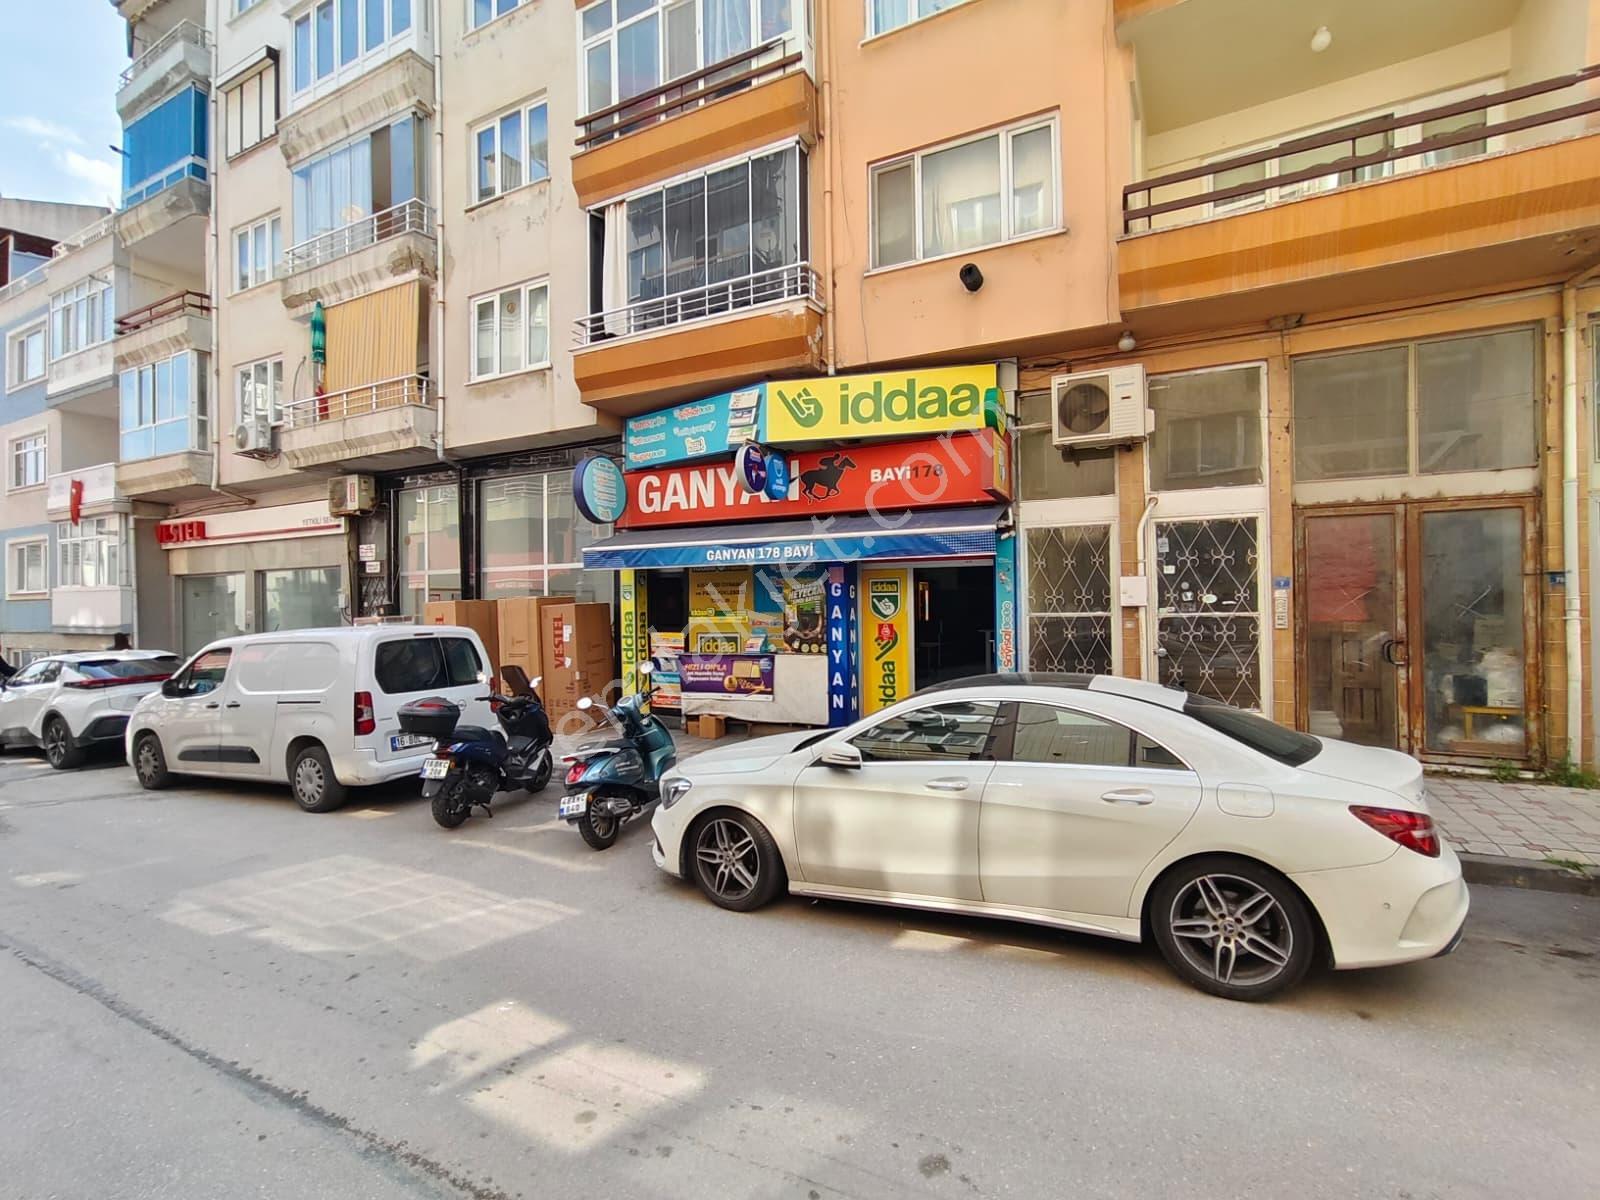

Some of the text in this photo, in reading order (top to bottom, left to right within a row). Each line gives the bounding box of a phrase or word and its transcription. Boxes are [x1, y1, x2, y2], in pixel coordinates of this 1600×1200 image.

[840, 378, 980, 425] iddaa
[638, 459, 800, 513] GANYN
[912, 463, 943, 479] 178
[706, 547, 755, 561] GANYAN
[757, 546, 779, 559] 178
[872, 582, 897, 592] iddaa
[552, 613, 566, 669] VESTEL
[623, 611, 635, 665] iddaa
[638, 611, 647, 661] ddaa
[701, 638, 737, 652] iddaa
[831, 583, 844, 709] GANYAN
[849, 584, 858, 712] GANYAN
[878, 660, 897, 707] ddaa
